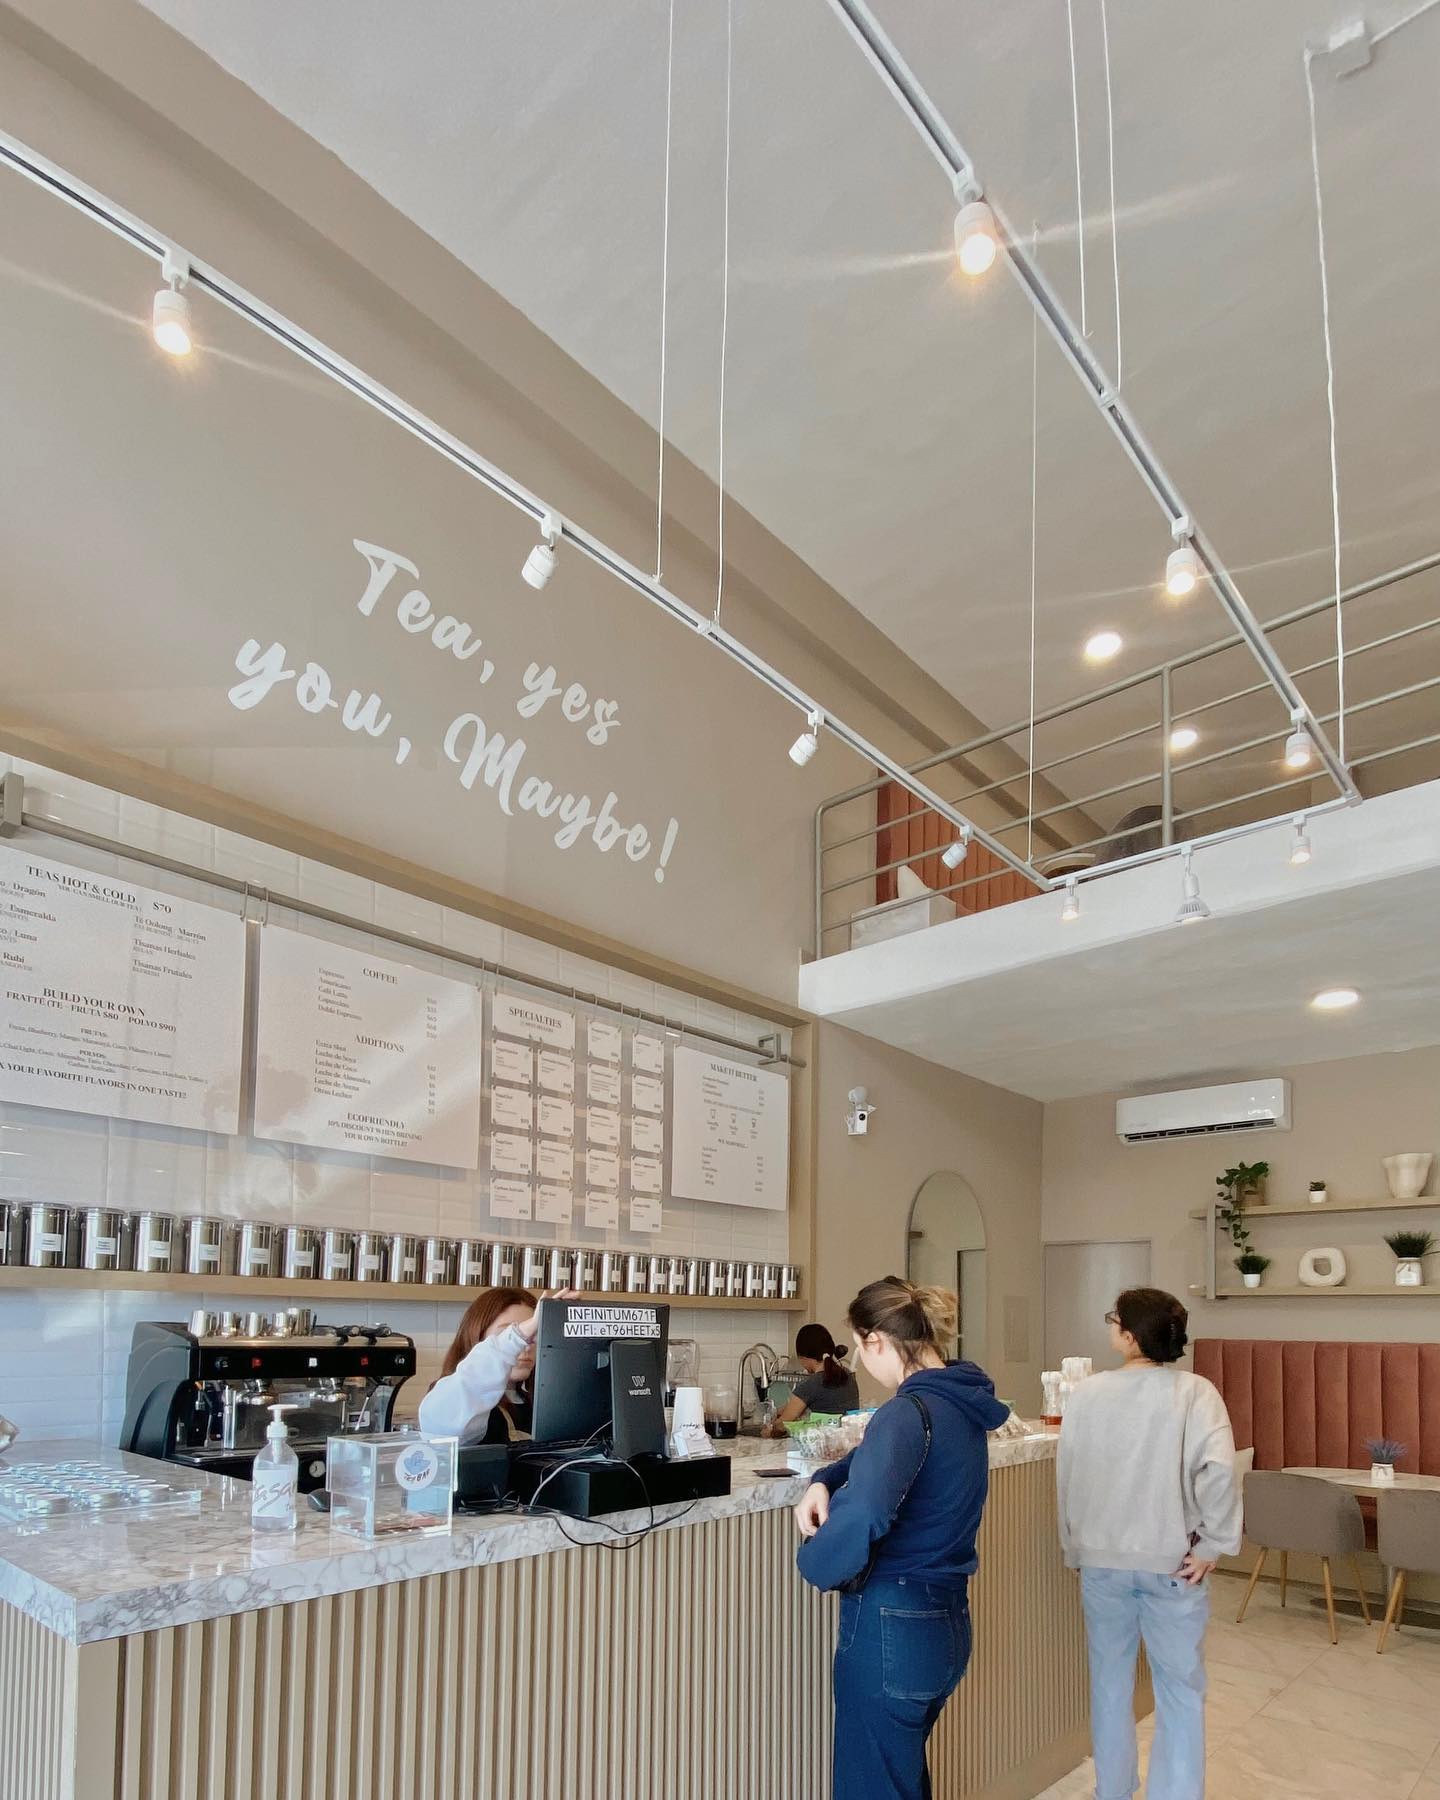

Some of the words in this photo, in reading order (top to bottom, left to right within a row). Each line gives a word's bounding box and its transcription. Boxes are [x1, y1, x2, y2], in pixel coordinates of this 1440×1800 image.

[352, 538, 494, 684] Tea,
[516, 662, 620, 746] yes
[228, 638, 412, 764] you,
[444, 712, 678, 884] Maybe!
[26, 864, 60, 882] TEAS
[62, 876, 90, 890] HOT
[92, 884, 100, 894] &
[102, 888, 136, 904] COLD
[152, 902, 172, 914] $70
[10, 902, 57, 922] Esmeralda
[14, 930, 38, 942] Luna
[362, 968, 398, 984] COFFEE
[6, 991, 45, 1006] FRATTE
[71, 1004, 101, 1017] FRUTA
[102, 1010, 119, 1021] $80
[128, 1016, 158, 1028] POLVO
[43, 987, 80, 1003] BUILD
[82, 996, 116, 1010] YOUR
[117, 1003, 146, 1016] OWN
[508, 1006, 562, 1028] SPECIALTIES
[354, 1034, 405, 1054] ADDITIONS
[7, 1062, 34, 1074] YOUR
[36, 1068, 84, 1082] FAVORITE
[85, 1076, 126, 1089] FLAVORS
[126, 1082, 136, 1091] IN
[138, 1086, 157, 1096] ONE
[347, 1112, 406, 1130] ECOFRIENDLY
[566, 1324, 598, 1336] WIFI:
